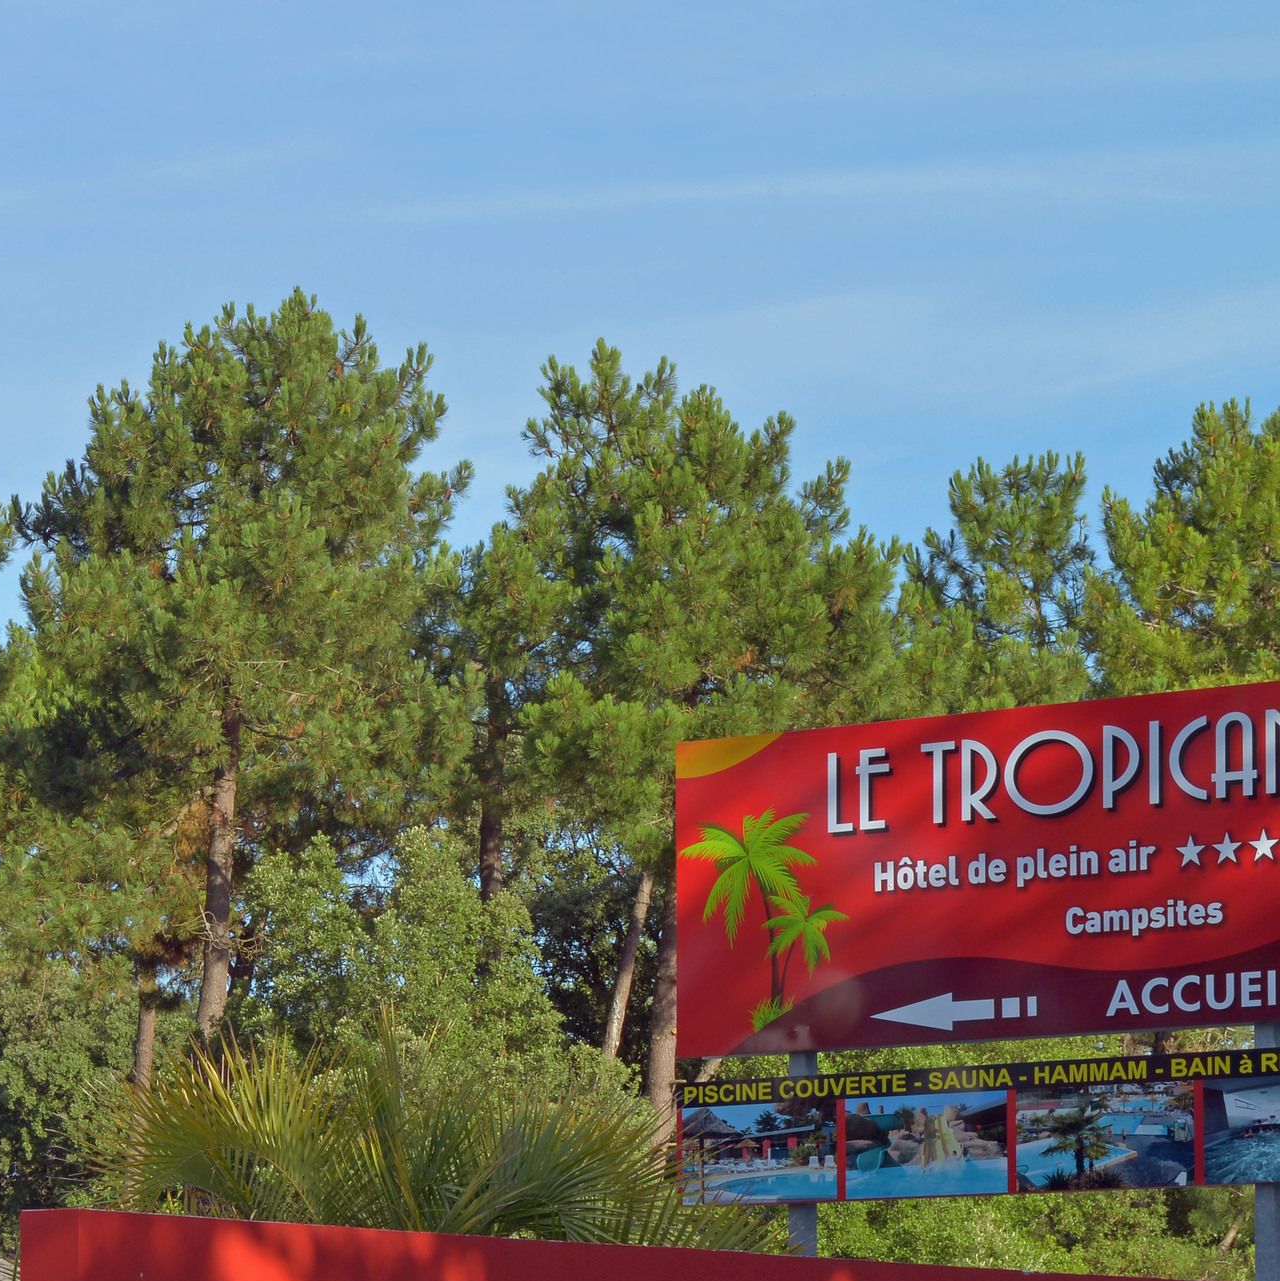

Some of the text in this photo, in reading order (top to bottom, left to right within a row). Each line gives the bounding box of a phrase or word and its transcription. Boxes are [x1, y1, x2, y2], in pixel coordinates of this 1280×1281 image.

[827, 747, 890, 834] LE
[874, 840, 1157, 893] Hôtel de plein air
[1065, 899, 1224, 936] Campsites
[683, 1082, 772, 1105] PISCINE
[779, 1074, 907, 1099] COUVERTE
[928, 1068, 1013, 1091] SAUNA
[1034, 1060, 1147, 1085] HAMMAM
[1170, 1055, 1231, 1078] BAIN
[1239, 1054, 1253, 1074] à
[1261, 1052, 1280, 1073] R
